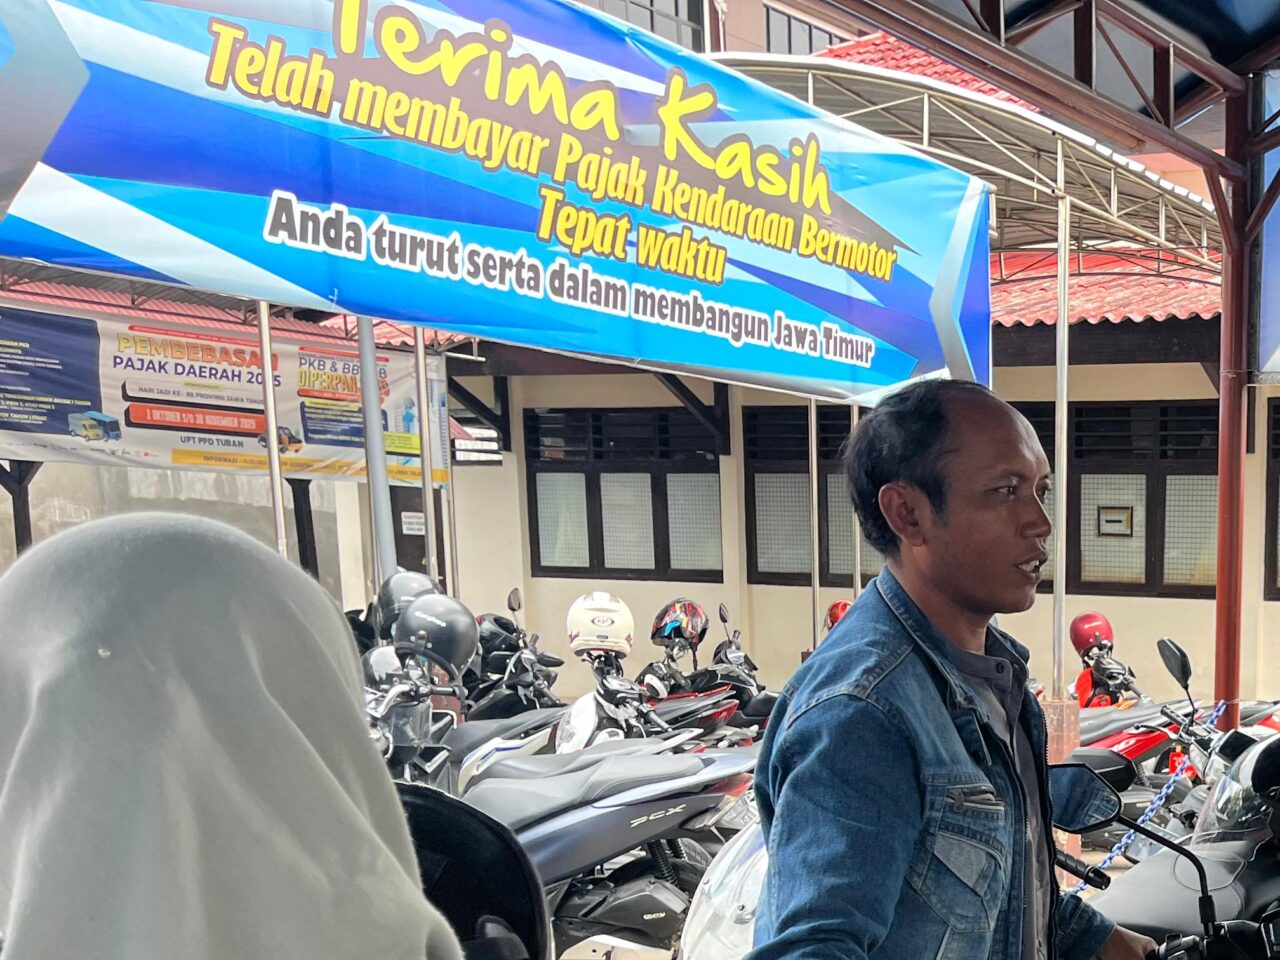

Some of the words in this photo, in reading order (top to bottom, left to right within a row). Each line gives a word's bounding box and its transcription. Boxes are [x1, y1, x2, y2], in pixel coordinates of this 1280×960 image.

[209, 22, 334, 114] Telah
[342, 78, 550, 174] membayar
[554, 133, 648, 206] Pajak
[651, 165, 795, 251] Kendaraan
[797, 213, 897, 281] Bermotor
[658, 75, 832, 215] Kasih
[268, 197, 363, 256] Anda
[371, 220, 459, 275] turut
[466, 248, 541, 294] serta
[549, 263, 627, 312] dalam
[634, 287, 769, 342] membangun
[774, 315, 818, 351] Jawa
[823, 326, 873, 364] Timur
[538, 188, 630, 259] Tepat
[637, 229, 727, 283] waktu
[113, 355, 169, 375] PAJAK
[174, 363, 242, 383] DAERAH
[246, 371, 281, 387] 205
[299, 357, 326, 371] PKB
[329, 361, 338, 373] &
[342, 363, 388, 379] BBB
[180, 435, 196, 444] UPT
[215, 438, 244, 448] TUBAN
